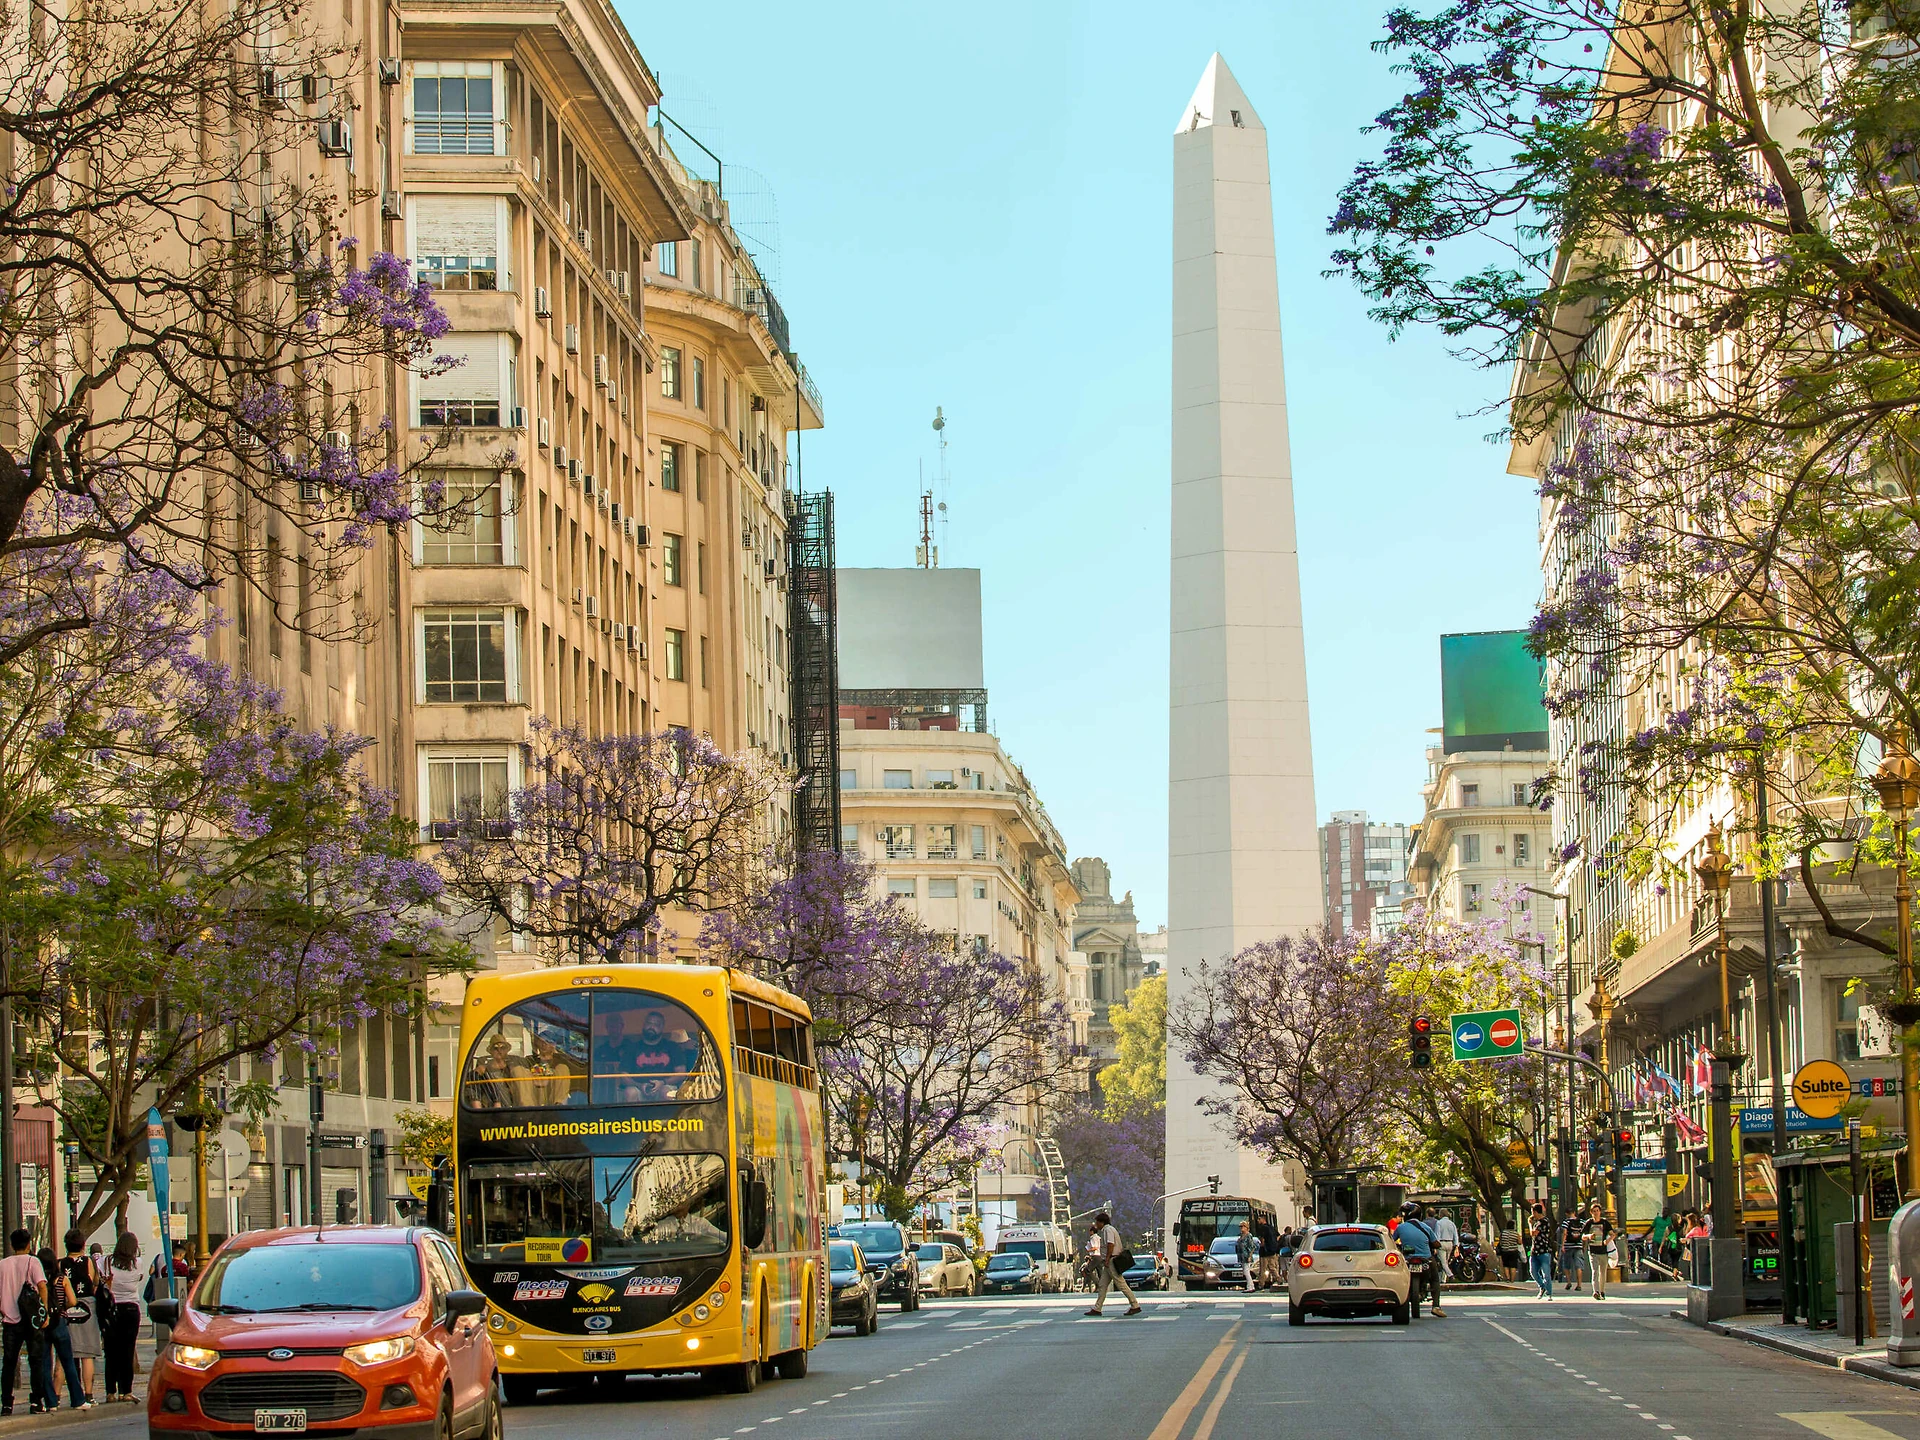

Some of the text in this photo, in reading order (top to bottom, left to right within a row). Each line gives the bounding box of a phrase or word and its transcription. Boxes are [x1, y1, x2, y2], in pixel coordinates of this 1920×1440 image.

[1801, 1080, 1844, 1093] Subte
[1861, 1083, 1894, 1092] C B D
[1745, 1110, 1788, 1122] Diagol
[480, 1117, 704, 1141] www.buenosairesbus.com
[1190, 1203, 1215, 1213] 29
[527, 1243, 560, 1251] RECORRIDO
[536, 1253, 551, 1262] TOUR
[1753, 1258, 1777, 1269] A B
[575, 1270, 619, 1278] METALSUR
[517, 1280, 569, 1290] flecha
[629, 1276, 682, 1286] flecha
[515, 1289, 565, 1299] BUS
[627, 1285, 678, 1295] BUS
[601, 1350, 615, 1360] 976
[257, 1414, 304, 1427] PDY 278
